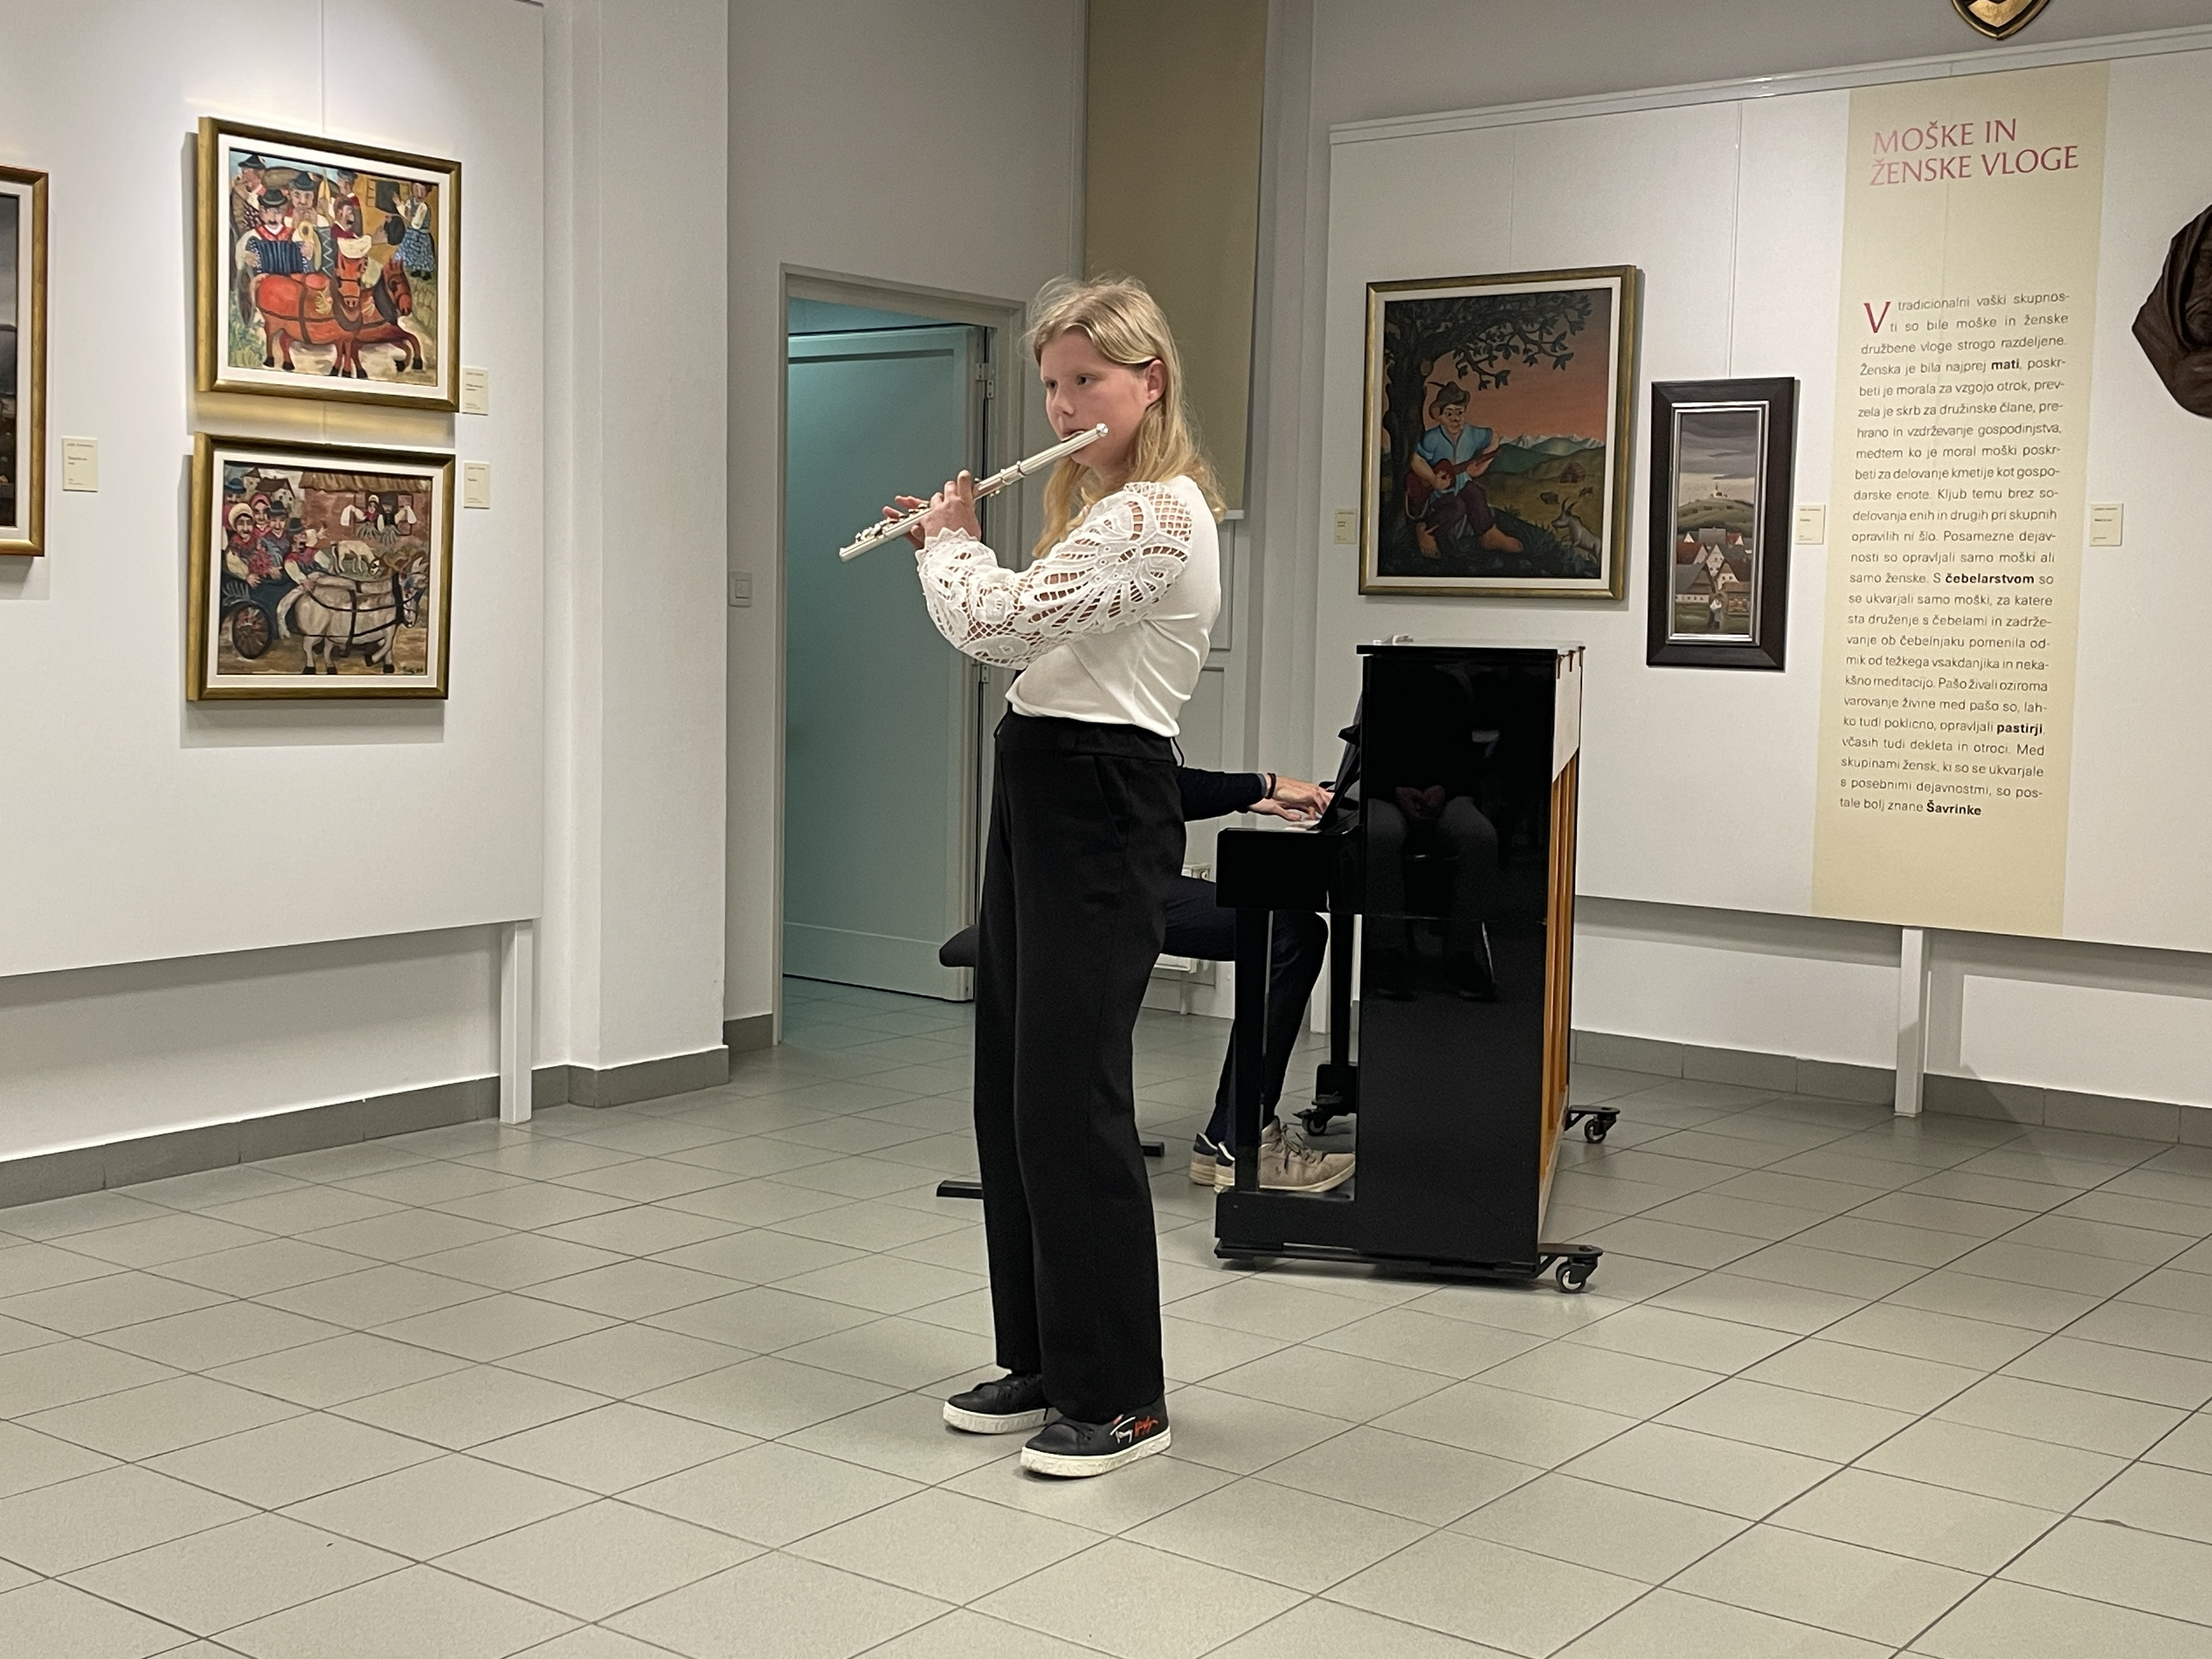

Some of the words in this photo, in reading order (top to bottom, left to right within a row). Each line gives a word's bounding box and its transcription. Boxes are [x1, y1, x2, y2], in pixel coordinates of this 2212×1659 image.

[1873, 120, 1974, 155] MOŠKE
[1986, 119, 2017, 143] IN
[1870, 155, 1972, 186] ŽENSKE
[1981, 145, 2079, 176] VLOGE
[1863, 302, 1891, 333] V
[1898, 297, 1970, 311] tradicionalni
[1977, 295, 2006, 306] vaški
[1891, 323, 1897, 332] ti
[1927, 320, 1948, 330] bile
[1956, 317, 1996, 329] moške
[2005, 317, 2016, 326] in
[2024, 314, 2068, 325] ženske
[1861, 343, 1916, 354] družbene
[1920, 341, 1952, 353] vloge
[1957, 340, 1995, 351] strogo
[1860, 363, 1900, 376] Ženska
[1905, 364, 1915, 376] je
[1921, 362, 1940, 373] bila
[1946, 361, 1987, 374] najprej
[1860, 386, 1880, 396] beti
[1882, 387, 1893, 398] je
[1897, 383, 1936, 395] morala
[1939, 385, 1952, 393] za
[1955, 383, 1994, 395] vzgojo
[1858, 407, 1880, 417] zela
[1882, 408, 1893, 419] je
[1896, 405, 1920, 416] skrb
[1923, 407, 1936, 415] za
[1939, 403, 1996, 415] družinske
[1857, 428, 1888, 438] hrano
[1893, 426, 1903, 436] in
[1908, 425, 1973, 438] vzdrževanje
[1856, 448, 1903, 459] medtem
[1909, 447, 1921, 458] ko
[1927, 448, 1937, 459] je
[1943, 446, 1976, 457] moral
[1982, 445, 2017, 456] moški
[1855, 469, 1876, 479] beti
[1893, 468, 1948, 480] delovanje
[1951, 467, 1994, 479] kmetije
[1997, 467, 2014, 477] kot
[1854, 489, 1892, 500] darske
[1938, 488, 1967, 500] Kljub
[1972, 489, 2002, 499] temu
[2008, 488, 2034, 498] brez
[1853, 510, 1906, 522] delovanja
[1909, 510, 1934, 520] enih
[1937, 510, 1947, 520] in
[1950, 509, 1988, 522] drugih
[1991, 510, 2007, 521] pri
[2009, 509, 2057, 521] skupnih
[1904, 531, 1914, 541] ni
[1944, 531, 2014, 541] Posamezne
[1850, 552, 1878, 563] nosti
[1884, 554, 1897, 563] so
[1903, 552, 1955, 565] opravljali
[1961, 554, 1993, 563] samo
[1999, 551, 2035, 563] moški
[2040, 553, 2055, 563] ali
[1850, 574, 1881, 583] samo
[1933, 572, 1940, 584] S
[1945, 572, 2034, 585] čebelarstvom
[2039, 576, 2053, 585] so
[1848, 595, 1862, 604] se
[1866, 594, 1914, 606] ukvarjali
[1917, 596, 1950, 605] samo
[1997, 597, 2010, 605] za
[2015, 595, 2052, 607] katere
[1848, 615, 1864, 624] sta
[1868, 614, 1918, 626] druženje
[1923, 617, 1928, 625] s
[1933, 615, 1988, 626] čebelami
[1991, 616, 2002, 627] in
[1847, 636, 1876, 647] vanje
[1881, 635, 1896, 645] ob
[1900, 635, 1964, 648] čebelnjaku
[1969, 636, 2025, 650] pomenila
[1846, 655, 1865, 665] mik
[1868, 656, 1882, 666] od
[1886, 656, 1929, 668] težkega
[1932, 657, 1999, 670] vsakdanjika
[2002, 659, 2013, 669] in
[1846, 675, 1871, 686] kšno
[1938, 677, 1967, 690] Pašo
[1969, 679, 1997, 690] živali
[2000, 681, 2047, 692] oziroma
[1844, 697, 1898, 709] varovanje
[1939, 699, 1965, 709] med
[1970, 701, 1999, 712] pašo
[1843, 716, 1856, 726] ko
[1860, 716, 1881, 727] tudi
[1940, 720, 1993, 733] opravljali
[1842, 736, 1878, 747] včasih
[1883, 738, 1905, 749] tudi
[1910, 739, 1953, 751] dekleta
[1958, 741, 1968, 752] in
[2017, 744, 2045, 755] Med
[1841, 757, 1900, 769] skupinami
[1943, 761, 1953, 771] ki
[1955, 764, 1969, 772] so
[1972, 765, 1986, 774] se
[1989, 764, 2044, 778] ukvarjale
[1840, 779, 1846, 787] s
[1851, 778, 1911, 791] posebnimi
[1996, 787, 2011, 796] so
[1840, 797, 1860, 808] tale
[1864, 798, 1884, 811] bolj
[1888, 802, 1923, 812] znane
